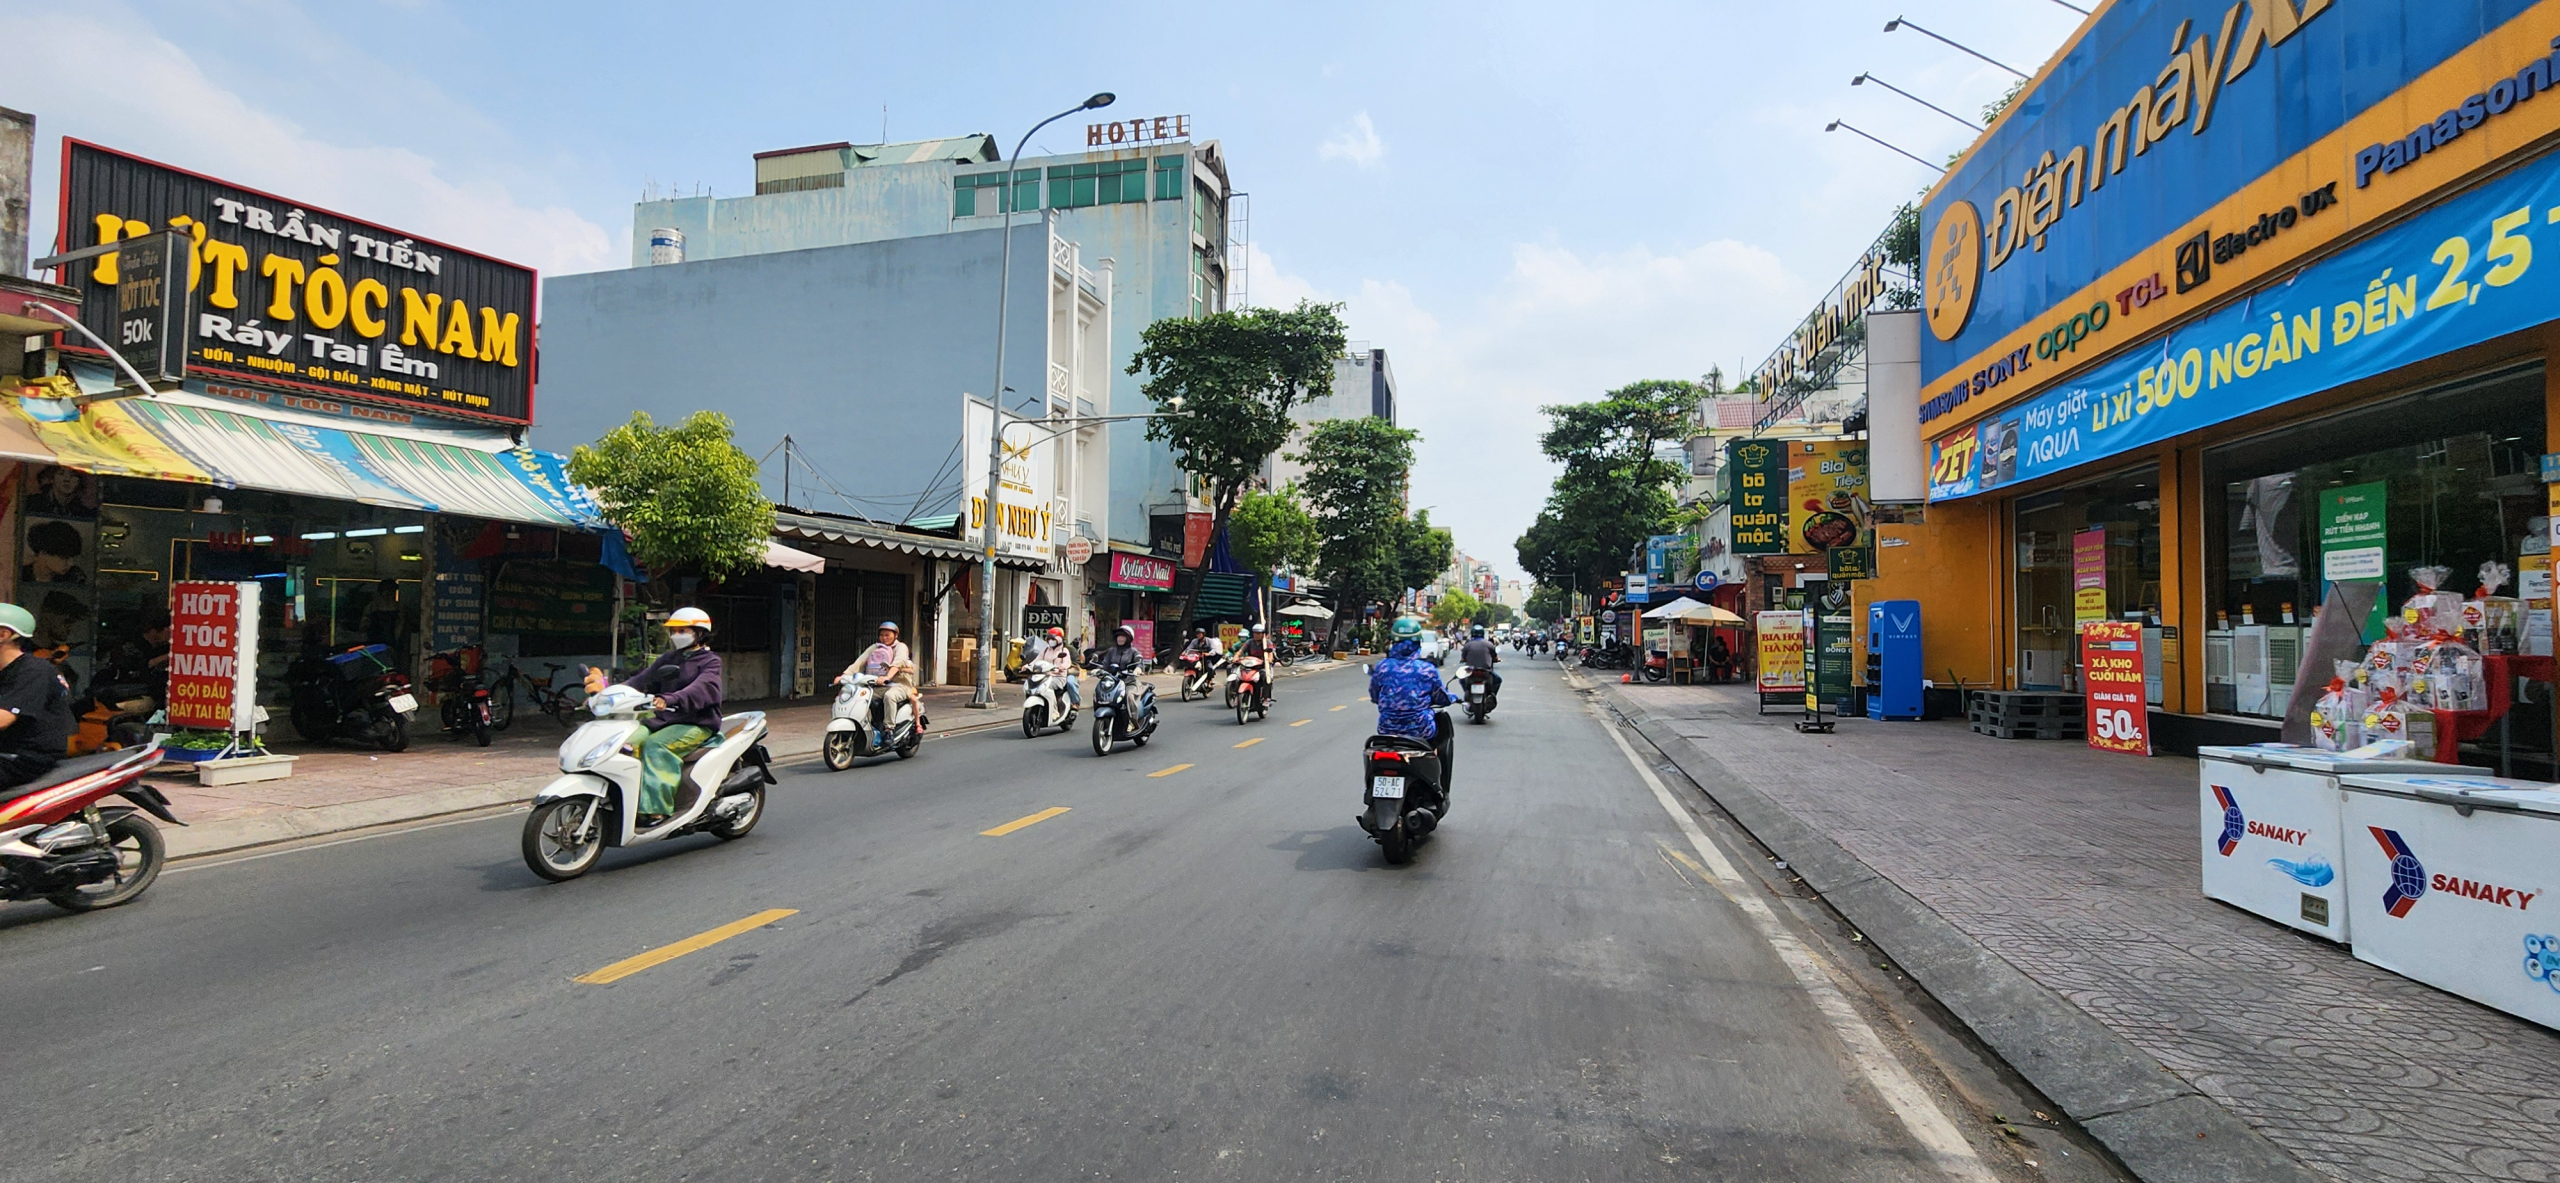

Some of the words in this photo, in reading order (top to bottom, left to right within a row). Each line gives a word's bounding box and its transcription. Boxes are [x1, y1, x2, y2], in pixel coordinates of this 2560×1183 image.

[1087, 115, 1189, 146] HOTEL
[1985, 145, 2088, 272] Điện
[213, 197, 341, 250] TRẦN
[349, 234, 442, 275] TIẾN
[2426, 205, 2532, 311] 2,5
[2116, 273, 2167, 316] TCL
[262, 252, 388, 338] TÓC
[400, 287, 519, 367] NAM
[1799, 301, 1840, 373] quán
[1843, 254, 1887, 327] mộc
[123, 317, 153, 345] 50k
[2136, 347, 2202, 415] 500
[2209, 307, 2321, 389] NGÀN
[2332, 267, 2417, 346] ĐẾN
[200, 313, 294, 355] Ráy
[303, 334, 369, 367] Tai
[379, 343, 438, 379] Êm
[203, 346, 234, 363] UỐN
[247, 355, 296, 374] NHUỘM
[308, 366, 330, 382] GỘI
[333, 369, 358, 385] ĐẦU
[371, 376, 402, 392] XÔNG
[404, 382, 428, 398] MẶT
[442, 388, 462, 403] HÚT
[465, 394, 489, 408] MỤN
[352, 405, 412, 425] NAM
[2025, 403, 2054, 433] Máy
[2057, 387, 2089, 425] giặt
[1935, 427, 1976, 483] TẾT
[972, 489, 1006, 533] ĐN
[1007, 503, 1039, 539] NHƯ
[1040, 501, 1052, 541] Ý
[1733, 510, 1777, 528] quán
[1737, 528, 1773, 546] mộc
[1153, 562, 1171, 581] Nail
[1028, 610, 1063, 624] ĐÈN
[182, 621, 227, 647] TÓC
[1222, 626, 1240, 637] CƠM
[1762, 633, 1780, 641] BIA
[1764, 643, 1780, 653] HÀ
[173, 653, 233, 678] NAM
[2089, 668, 2115, 682] CUỐI
[2116, 670, 2142, 683] NĂM
[2110, 658, 2133, 669] KHO
[178, 681, 199, 700] GỘI
[202, 681, 227, 699] ĐẦU
[195, 703, 211, 719] TAI
[215, 703, 231, 720] ÊM
[2096, 708, 2142, 740] 50%
[2247, 820, 2308, 846] SANAKY
[2431, 873, 2535, 910] SANAKY
